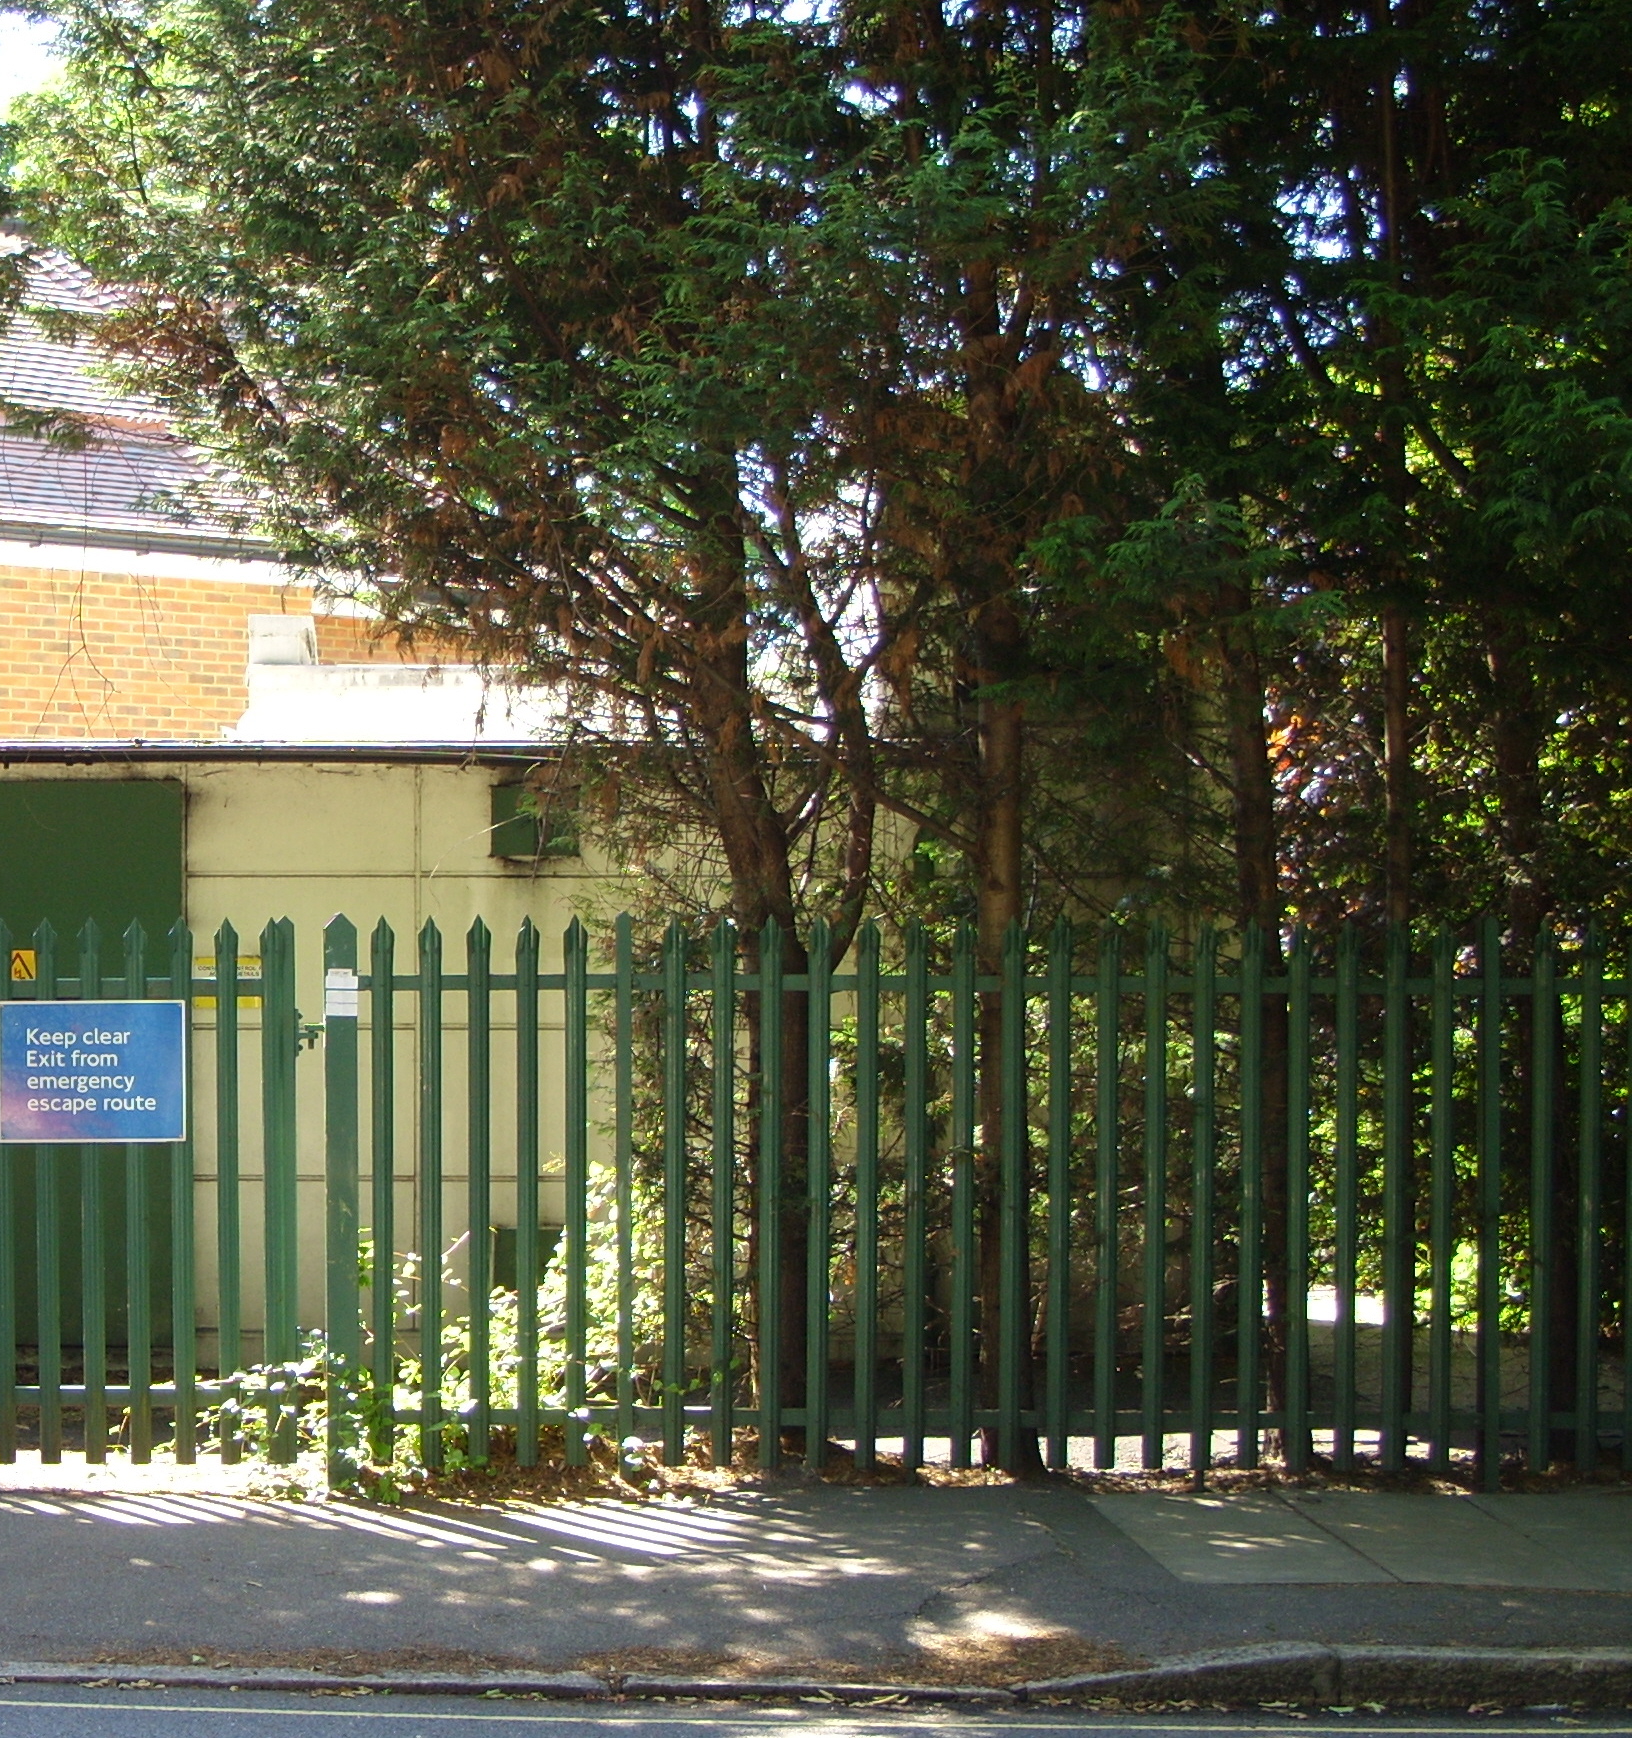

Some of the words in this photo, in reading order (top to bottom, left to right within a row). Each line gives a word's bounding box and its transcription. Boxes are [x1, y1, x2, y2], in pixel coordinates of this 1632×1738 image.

[26, 1028, 76, 1049] Keep
[82, 1028, 130, 1045] clear
[26, 1050, 66, 1067] Exit
[71, 1050, 118, 1067] from
[27, 1075, 135, 1093] emergency
[27, 1097, 97, 1115] escape
[104, 1096, 157, 1111] route
